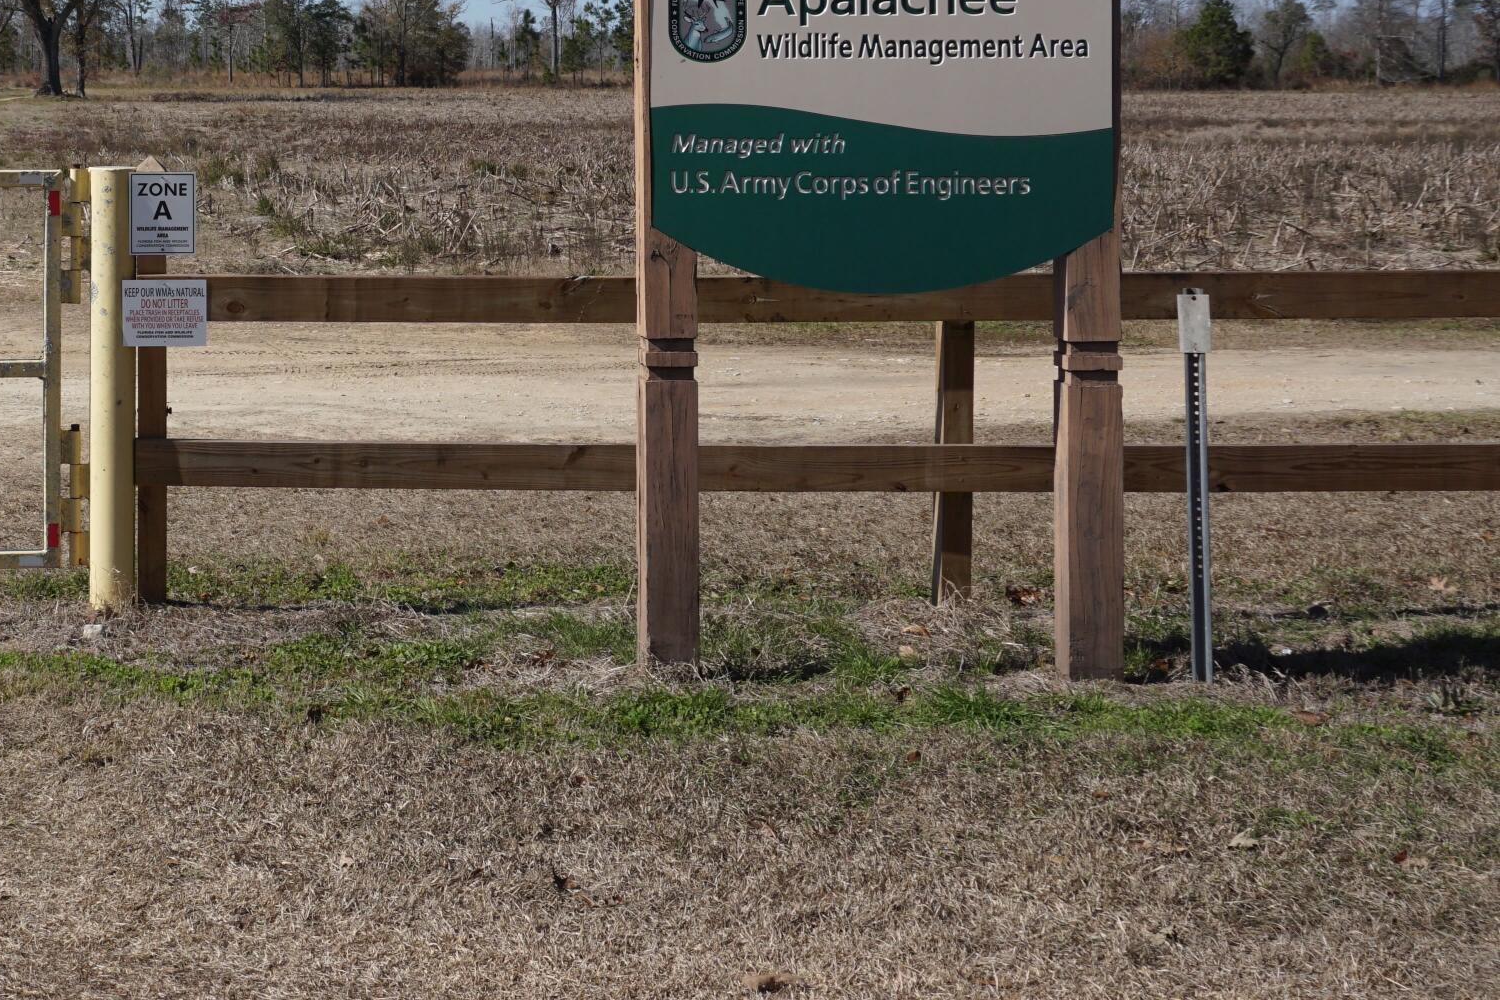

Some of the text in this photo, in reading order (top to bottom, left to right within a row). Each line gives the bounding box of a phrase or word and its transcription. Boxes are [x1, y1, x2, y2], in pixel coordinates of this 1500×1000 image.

[671, 19, 744, 60] CONSERVATION COMMISSION
[757, 33, 1090, 65] Wildlife Management Area
[672, 131, 846, 159] Managed with
[138, 183, 187, 196] ZONE
[670, 169, 1031, 201] U.S. Army Corps of Engineers
[153, 200, 172, 220] A
[124, 288, 204, 297] KEEP OUR WMAs NATURAL
[141, 299, 188, 308] DO NOT LITTER
